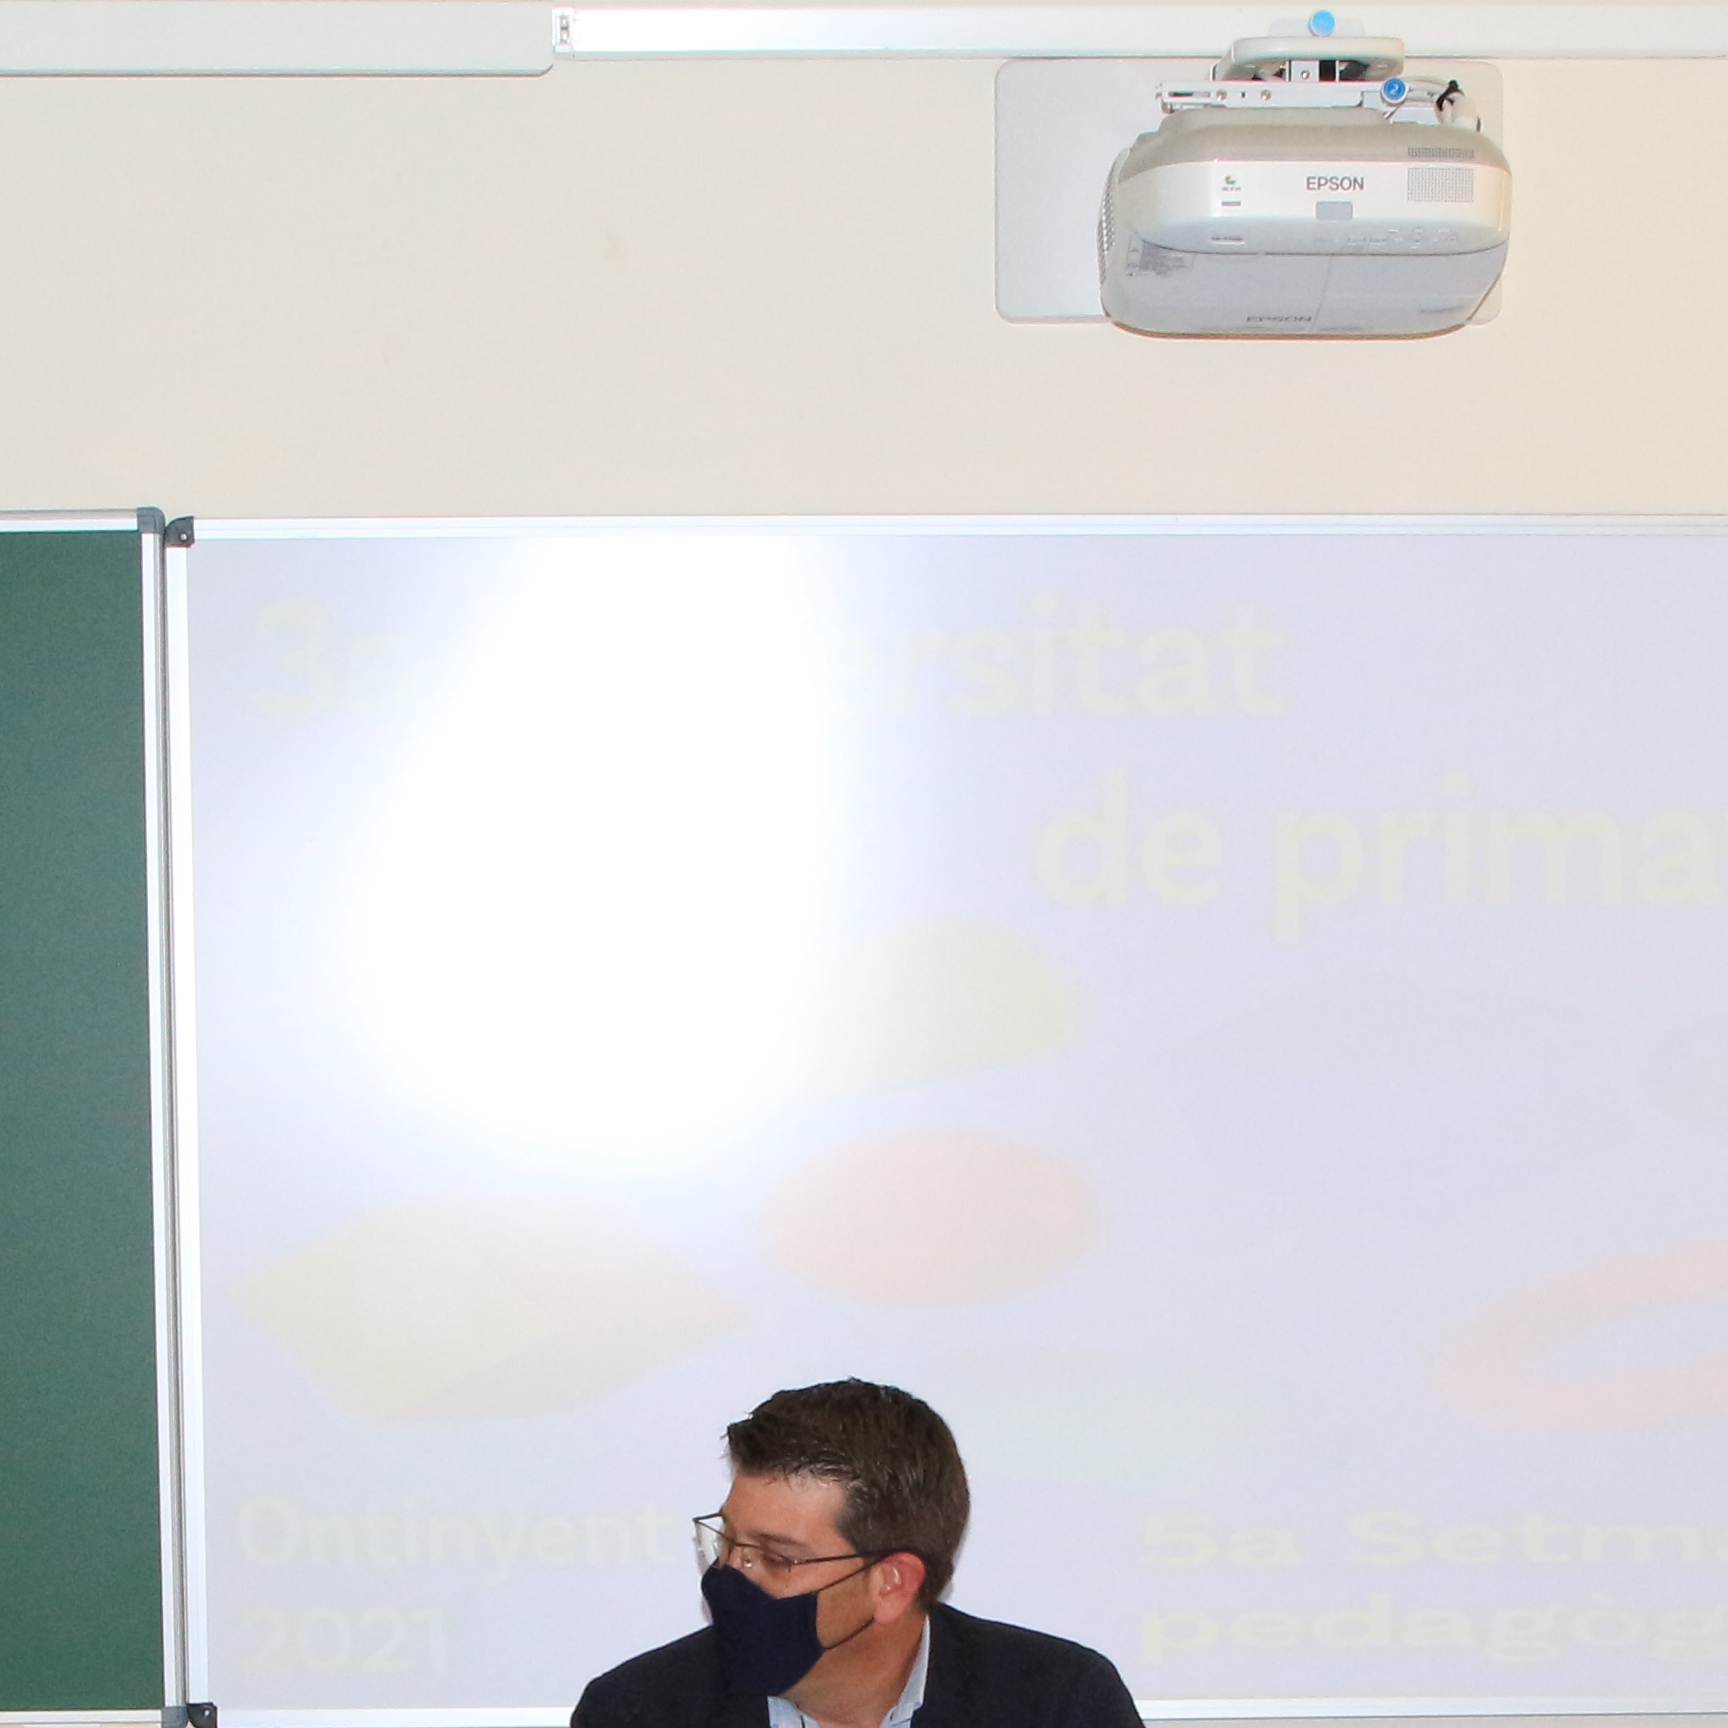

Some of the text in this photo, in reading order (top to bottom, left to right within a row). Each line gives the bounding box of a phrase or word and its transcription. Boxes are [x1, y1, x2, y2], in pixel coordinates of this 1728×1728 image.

[1305, 175, 1365, 192] EPSON
[245, 596, 410, 722] 3a
[1029, 768, 1226, 908] de
[1141, 1508, 1306, 1572] 5a
[235, 1604, 454, 1678] 2021
